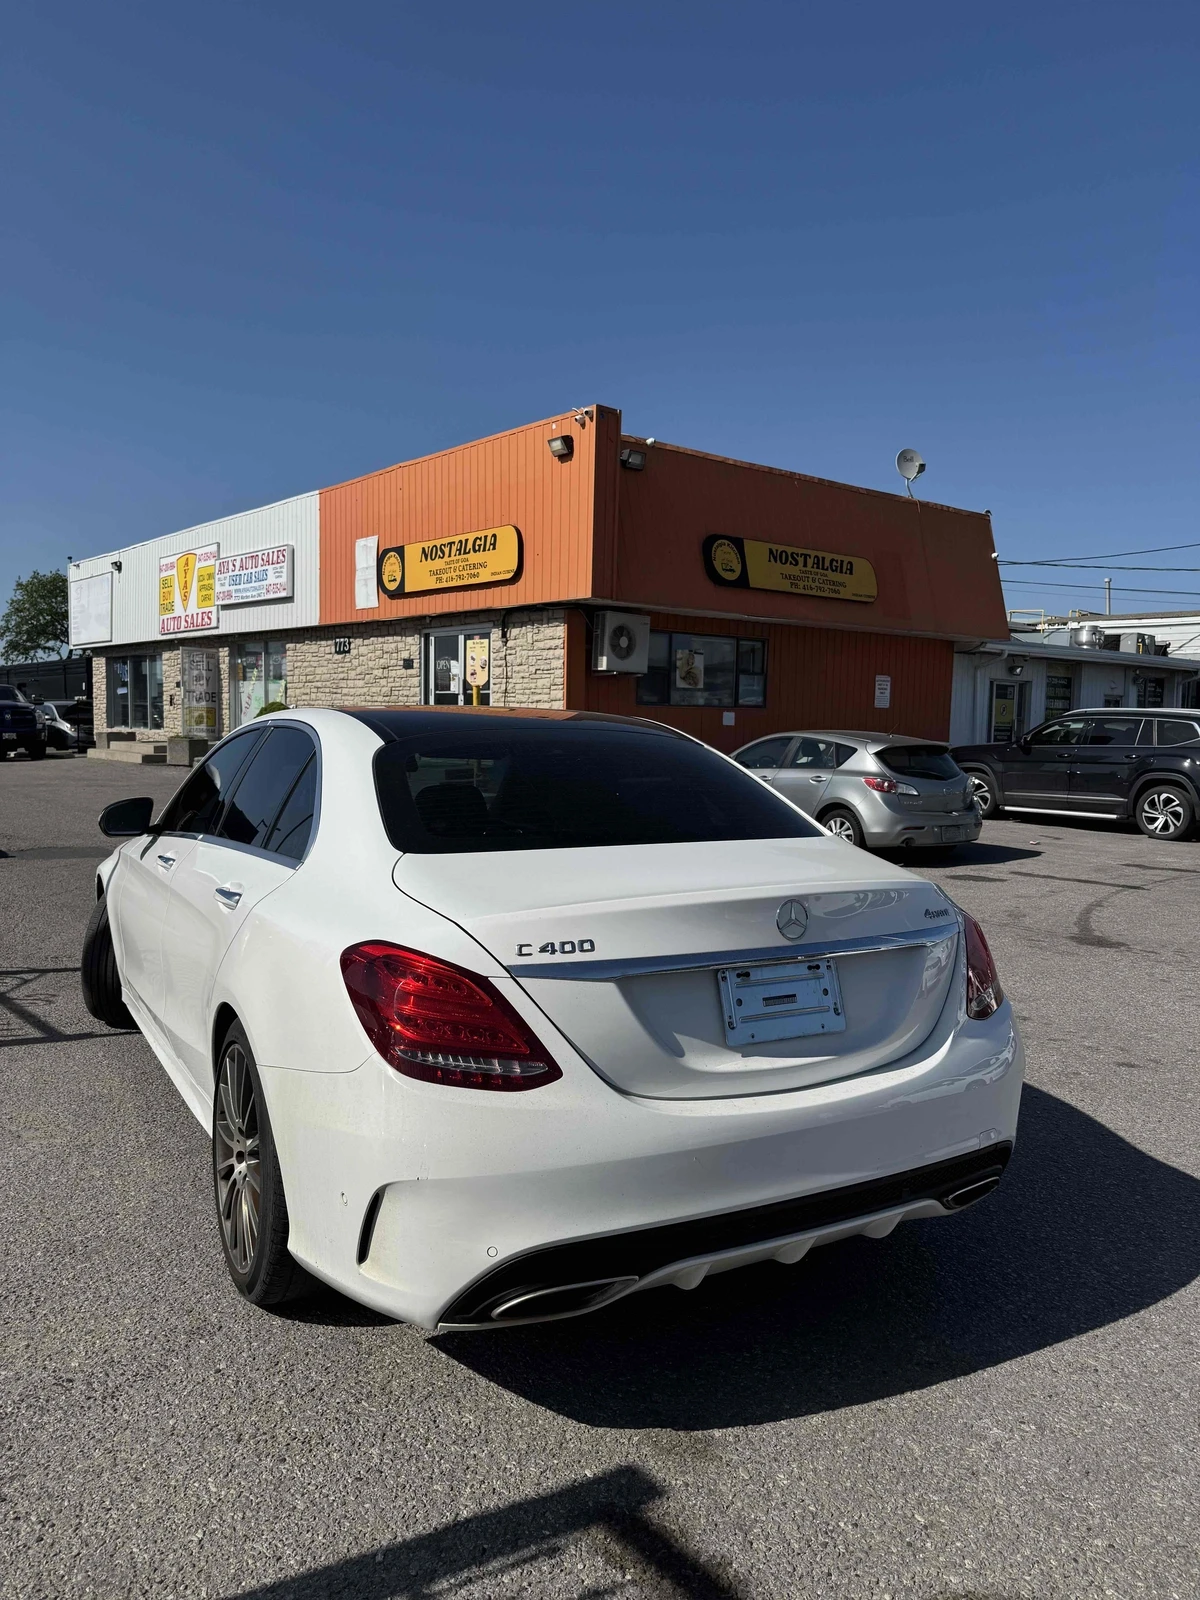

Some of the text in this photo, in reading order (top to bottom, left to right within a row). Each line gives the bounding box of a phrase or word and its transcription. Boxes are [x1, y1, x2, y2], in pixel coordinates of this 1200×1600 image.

[419, 533, 498, 563] NOSTALGIA
[216, 548, 287, 576] AYA'S AUTO SALES
[767, 547, 854, 576] NOSTALGIA
[428, 567, 452, 577] TAKEOUT
[456, 561, 488, 574] CATERING
[161, 577, 173, 590] SELL
[228, 573, 243, 587] USED
[243, 571, 254, 585] CAR
[254, 568, 269, 583] SALES
[434, 571, 480, 584] PH: 416-792-7060
[780, 573, 811, 583] TAKEOUT
[817, 577, 847, 589] CATERING
[789, 581, 841, 595] PH: 416-792-7060
[162, 590, 172, 602] BUY
[160, 601, 175, 613] TRADE
[160, 610, 213, 633] AUTO SALES
[335, 638, 350, 652] 773
[189, 660, 213, 672] SELL
[436, 660, 450, 670] OPEN
[192, 675, 211, 687] BUY
[185, 690, 217, 703] TRADE
[515, 938, 596, 957] C 400
